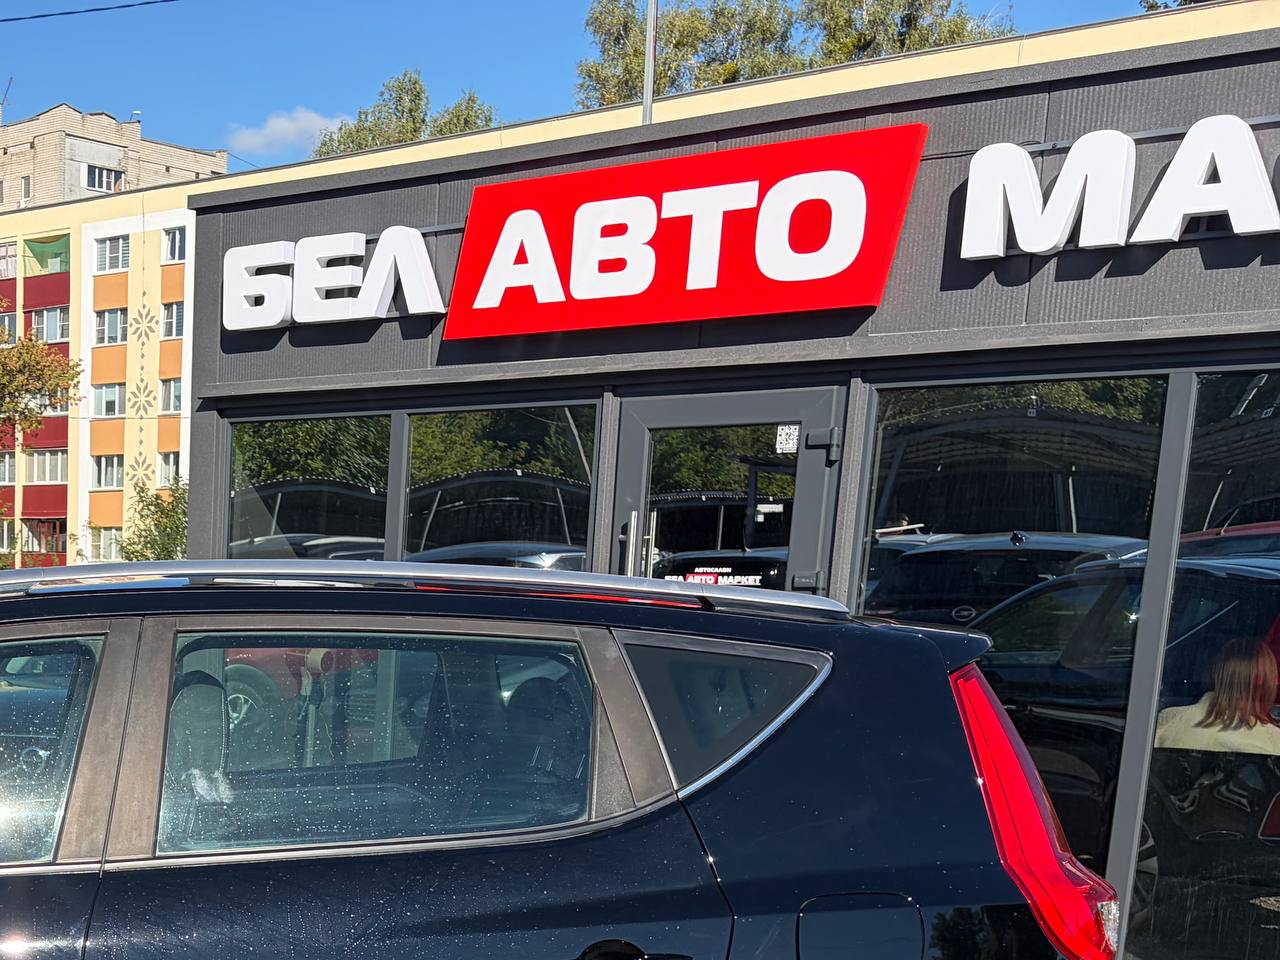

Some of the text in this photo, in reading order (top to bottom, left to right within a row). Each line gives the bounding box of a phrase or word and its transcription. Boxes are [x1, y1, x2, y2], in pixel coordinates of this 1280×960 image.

[222, 114, 1280, 331] БЕЛ АВТО МА
[717, 575, 762, 585] МАРКЕТ
